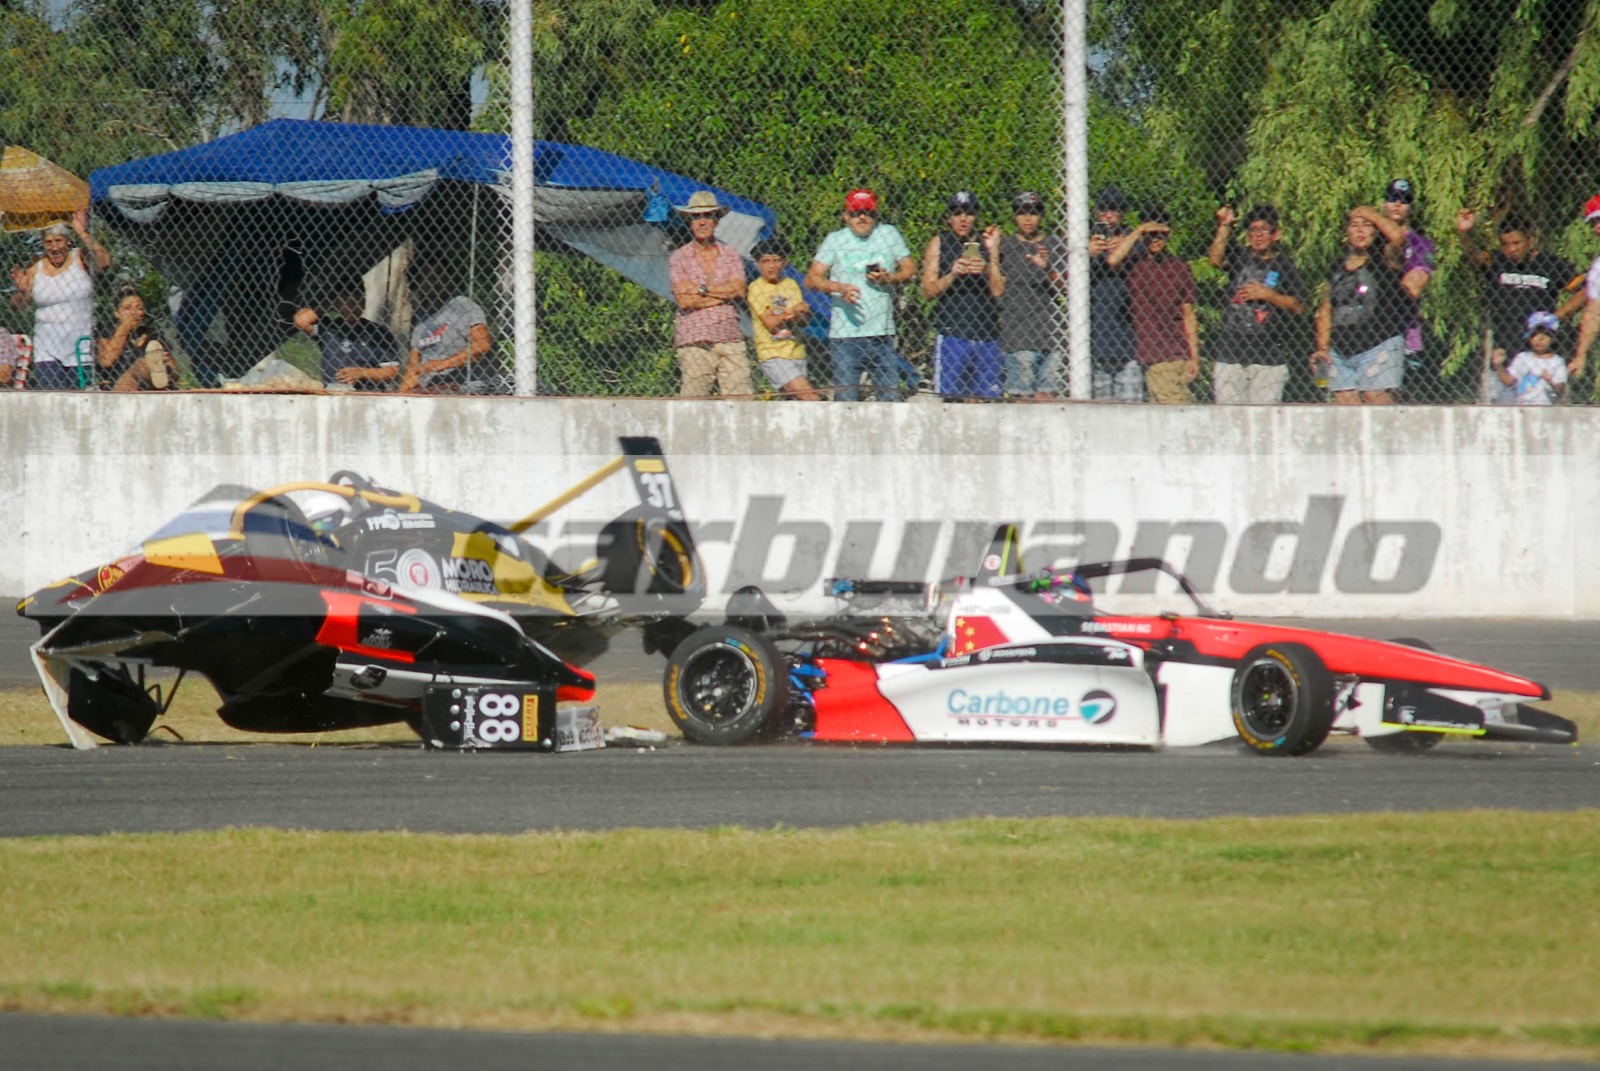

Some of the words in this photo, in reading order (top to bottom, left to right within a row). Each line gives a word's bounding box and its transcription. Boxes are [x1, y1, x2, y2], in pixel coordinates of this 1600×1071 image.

[641, 472, 674, 509] 37
[441, 556, 495, 582] MORO
[946, 688, 1070, 716] Carbone
[478, 692, 520, 743] 88
[957, 718, 1058, 728] MOTORS
